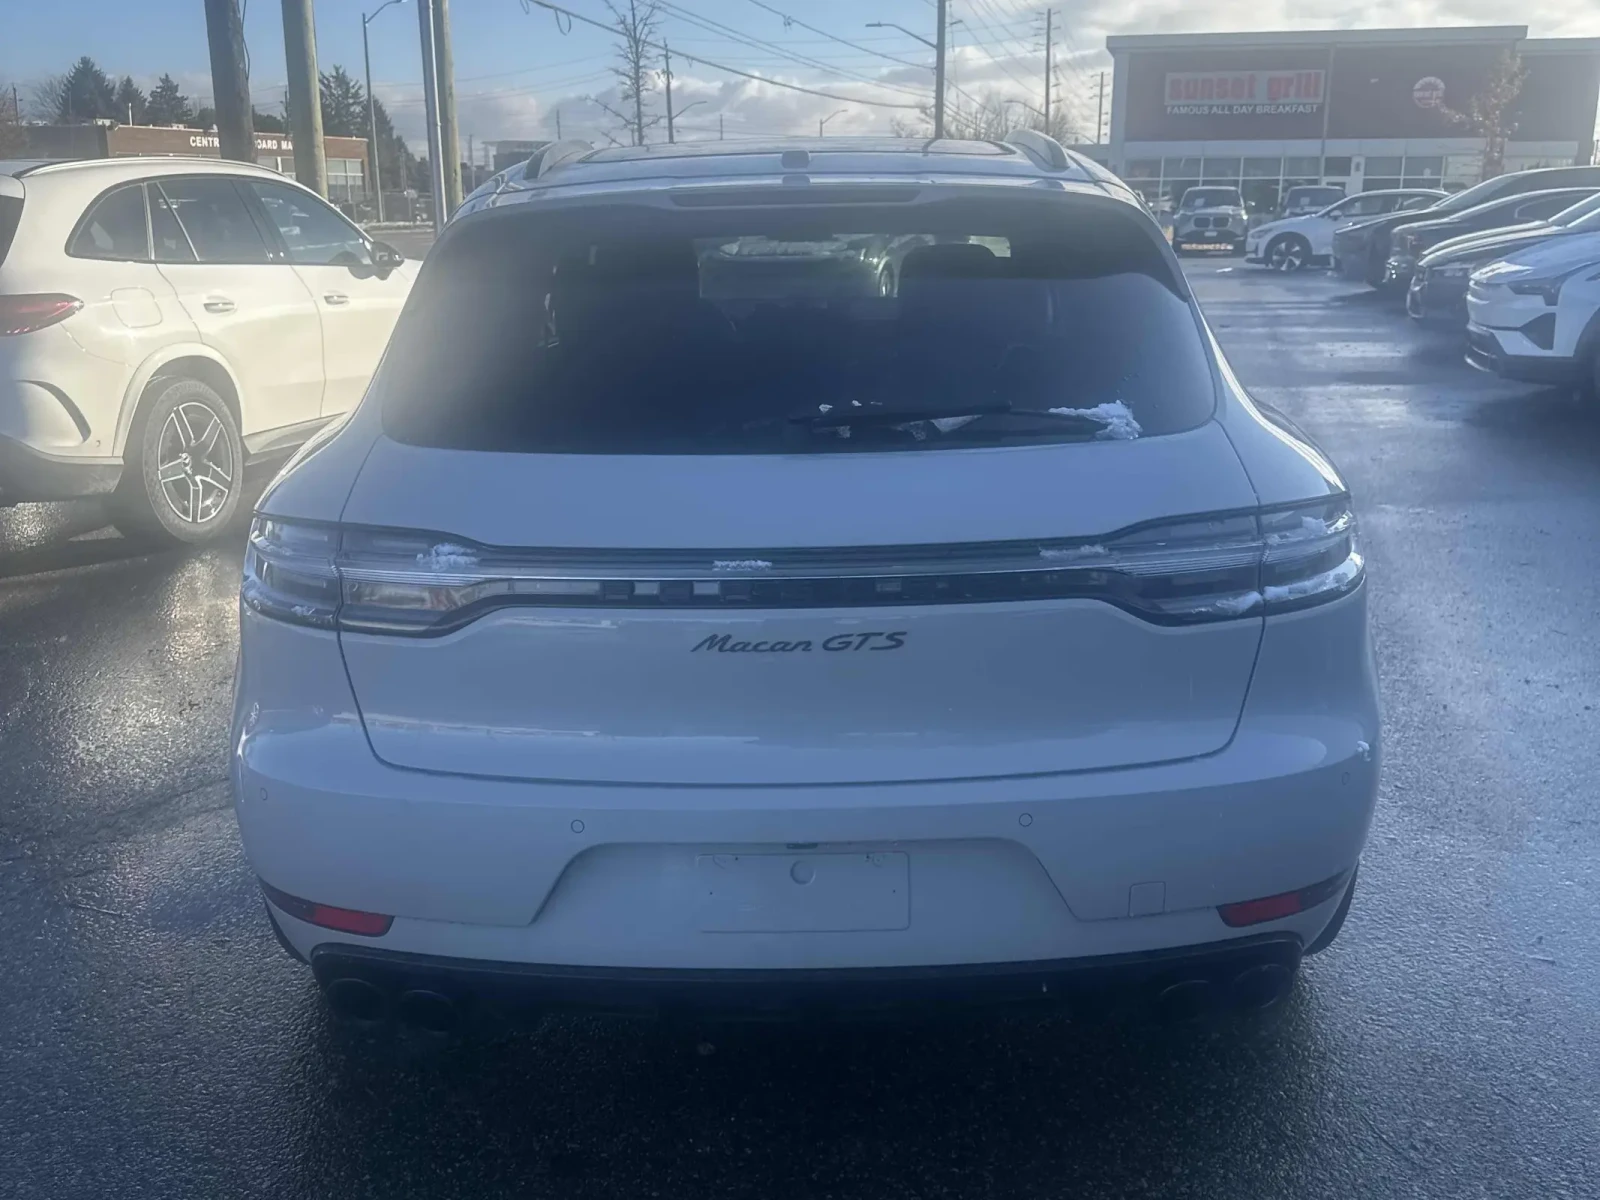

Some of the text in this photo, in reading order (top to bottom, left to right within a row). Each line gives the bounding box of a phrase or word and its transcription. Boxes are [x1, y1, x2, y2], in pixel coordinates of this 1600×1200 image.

[1169, 71, 1320, 103] sunset grill
[1167, 103, 1318, 115] FAMOUS ALL DAY BREAKFAST
[190, 136, 293, 150] CENTR OARD MA
[690, 631, 908, 652] Macan GTS
